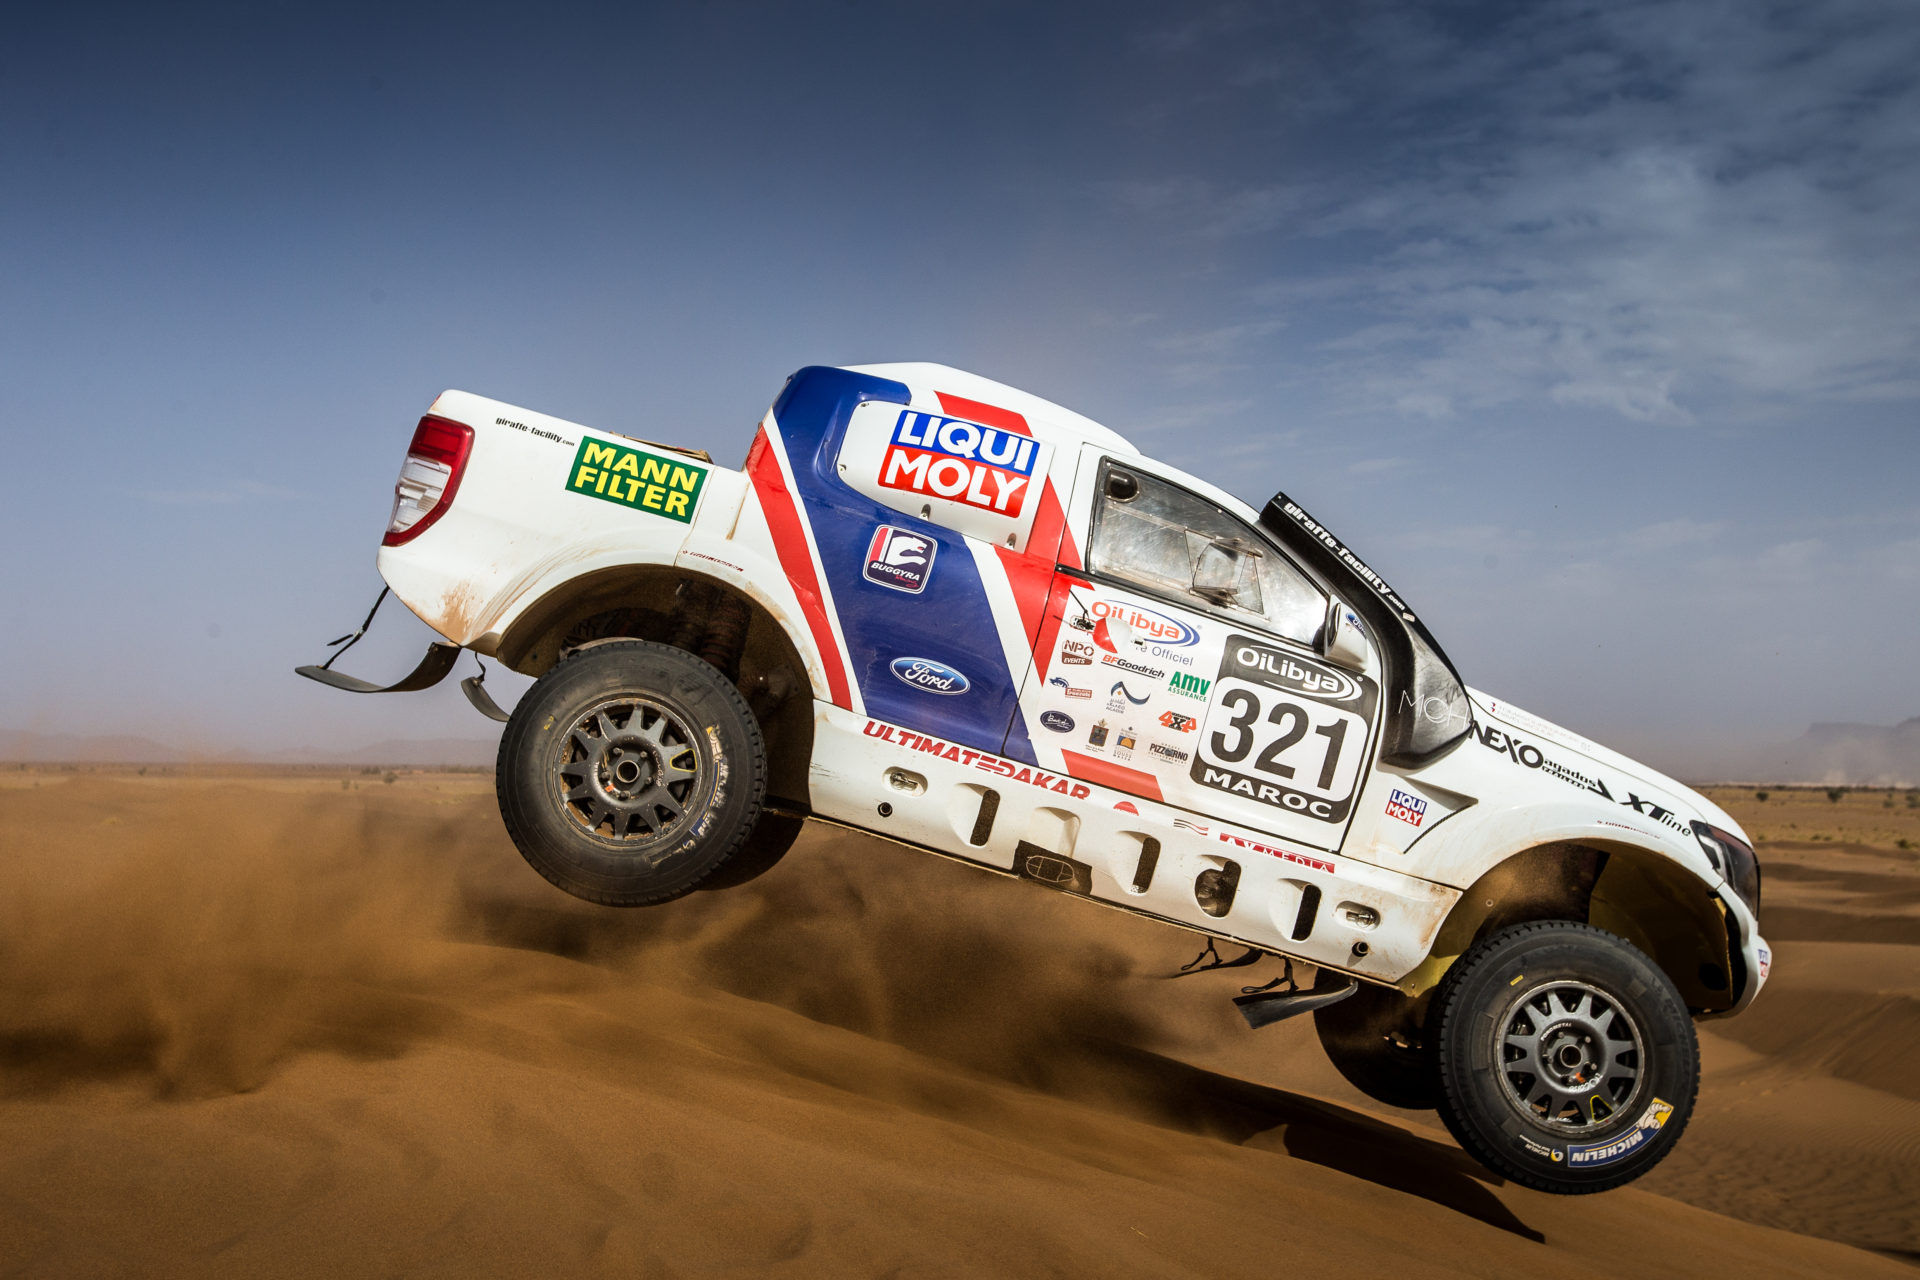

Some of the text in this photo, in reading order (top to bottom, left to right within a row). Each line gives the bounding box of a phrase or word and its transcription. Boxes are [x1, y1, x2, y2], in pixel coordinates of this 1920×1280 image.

[495, 416, 575, 447] giraffe-facility.com
[897, 411, 1034, 472] LIQUI
[582, 441, 699, 493] MANN
[884, 449, 1028, 511] MOLY
[574, 464, 690, 518] FILTER
[871, 562, 920, 581] BUGGYRA
[1283, 501, 1406, 611] giraffe-facility.com
[1064, 639, 1095, 657] NPO
[1152, 646, 1194, 667] Officiel
[905, 662, 955, 690] Ford
[1102, 654, 1166, 679] BFGoodrich
[1236, 646, 1340, 693] OiLibya
[1168, 687, 1207, 703] ASSURANCE
[1210, 688, 1350, 791] 321
[1469, 720, 1544, 769] NEXO
[1203, 769, 1332, 818] MAROC
[1391, 790, 1426, 813] LIQUI
[1386, 802, 1422, 825] MOLY
[1571, 1130, 1644, 1162] MICHELIN
